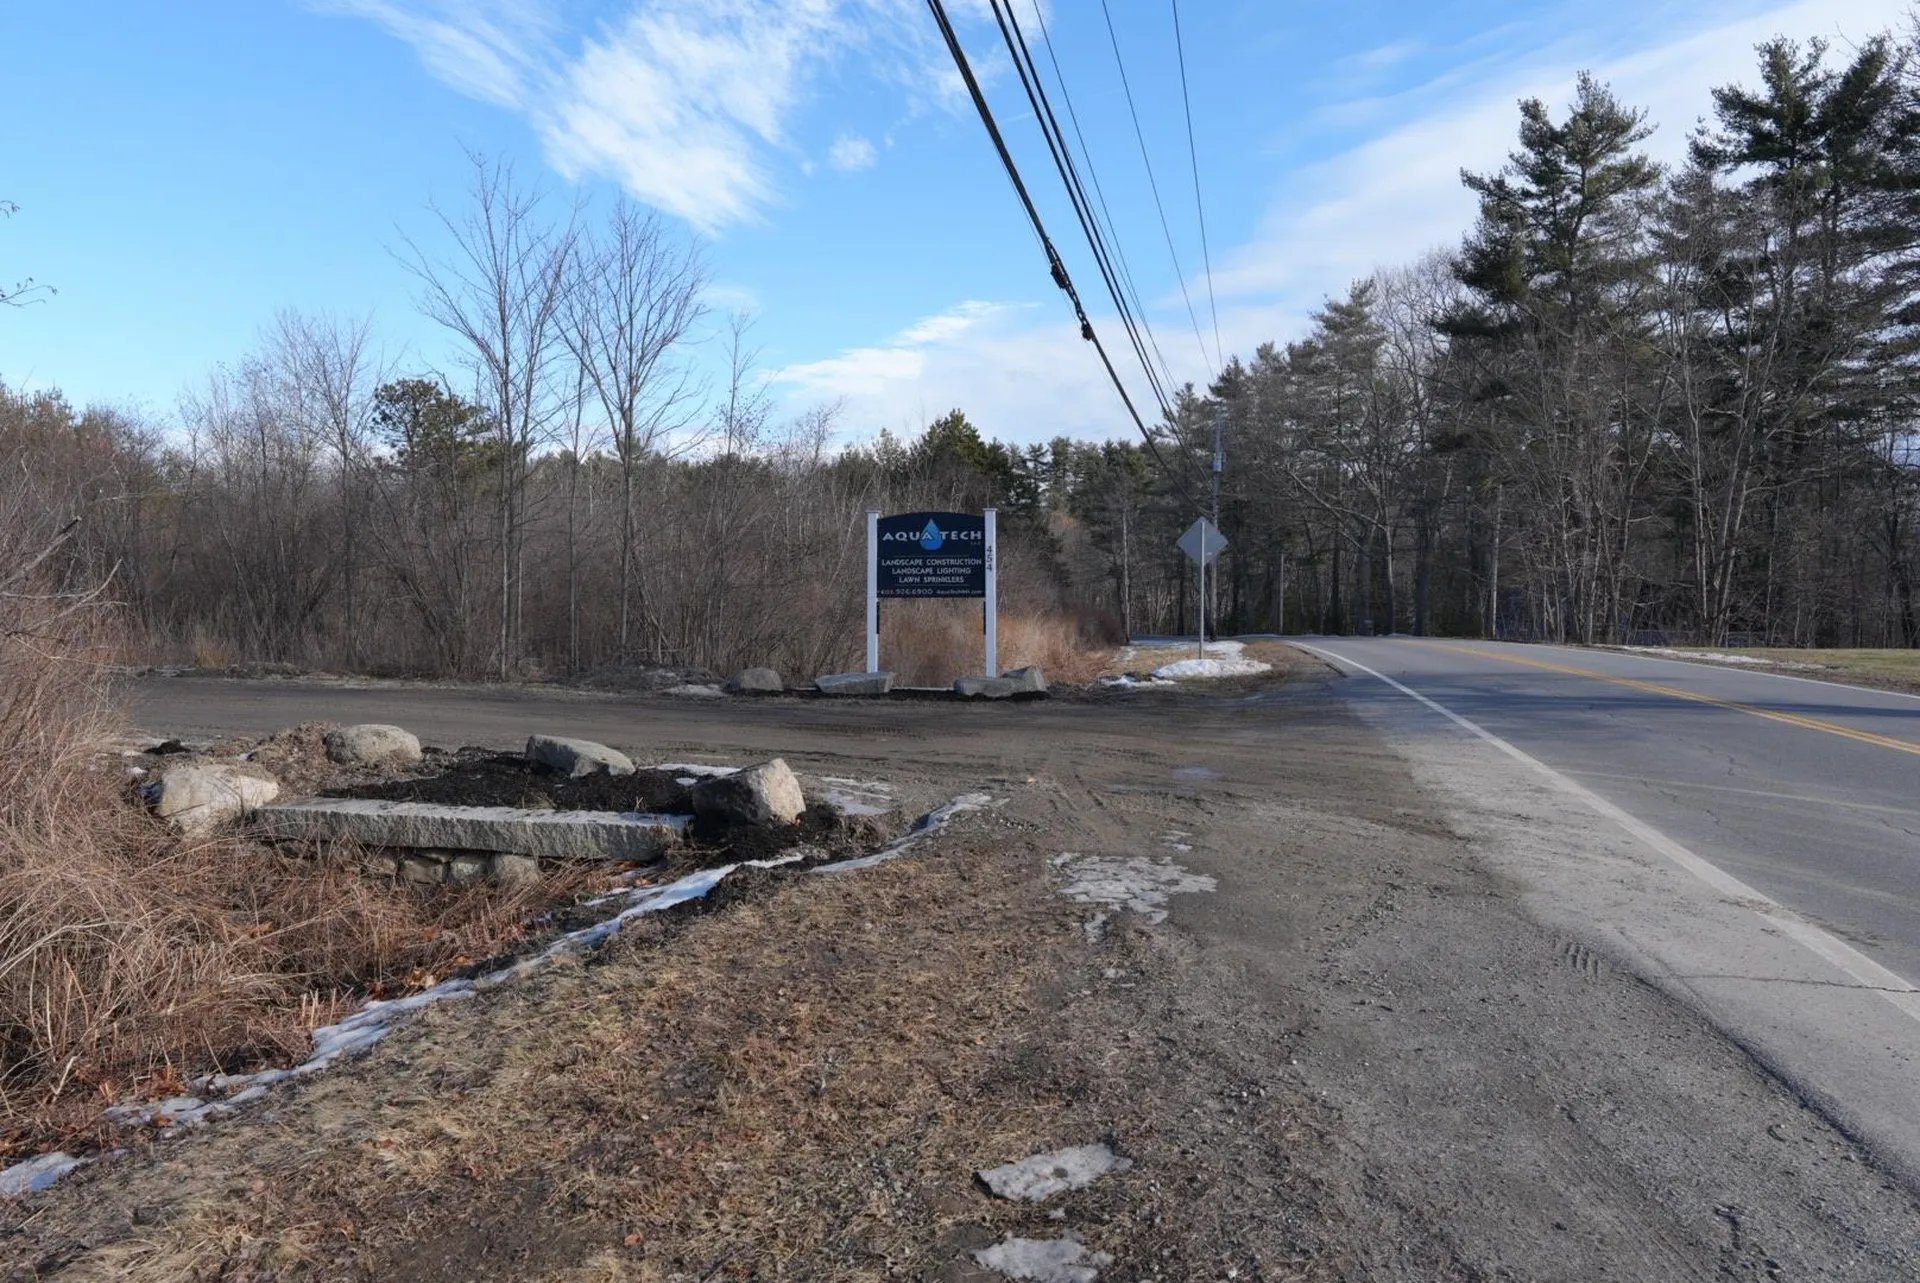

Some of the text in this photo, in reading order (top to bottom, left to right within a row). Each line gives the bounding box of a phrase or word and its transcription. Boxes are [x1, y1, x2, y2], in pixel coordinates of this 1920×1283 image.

[882, 530, 982, 542] AQUA TECH
[881, 558, 982, 566] LANDSCAPE CONSTRUCTION
[891, 567, 972, 575] LANDSCAPE LIGHTING
